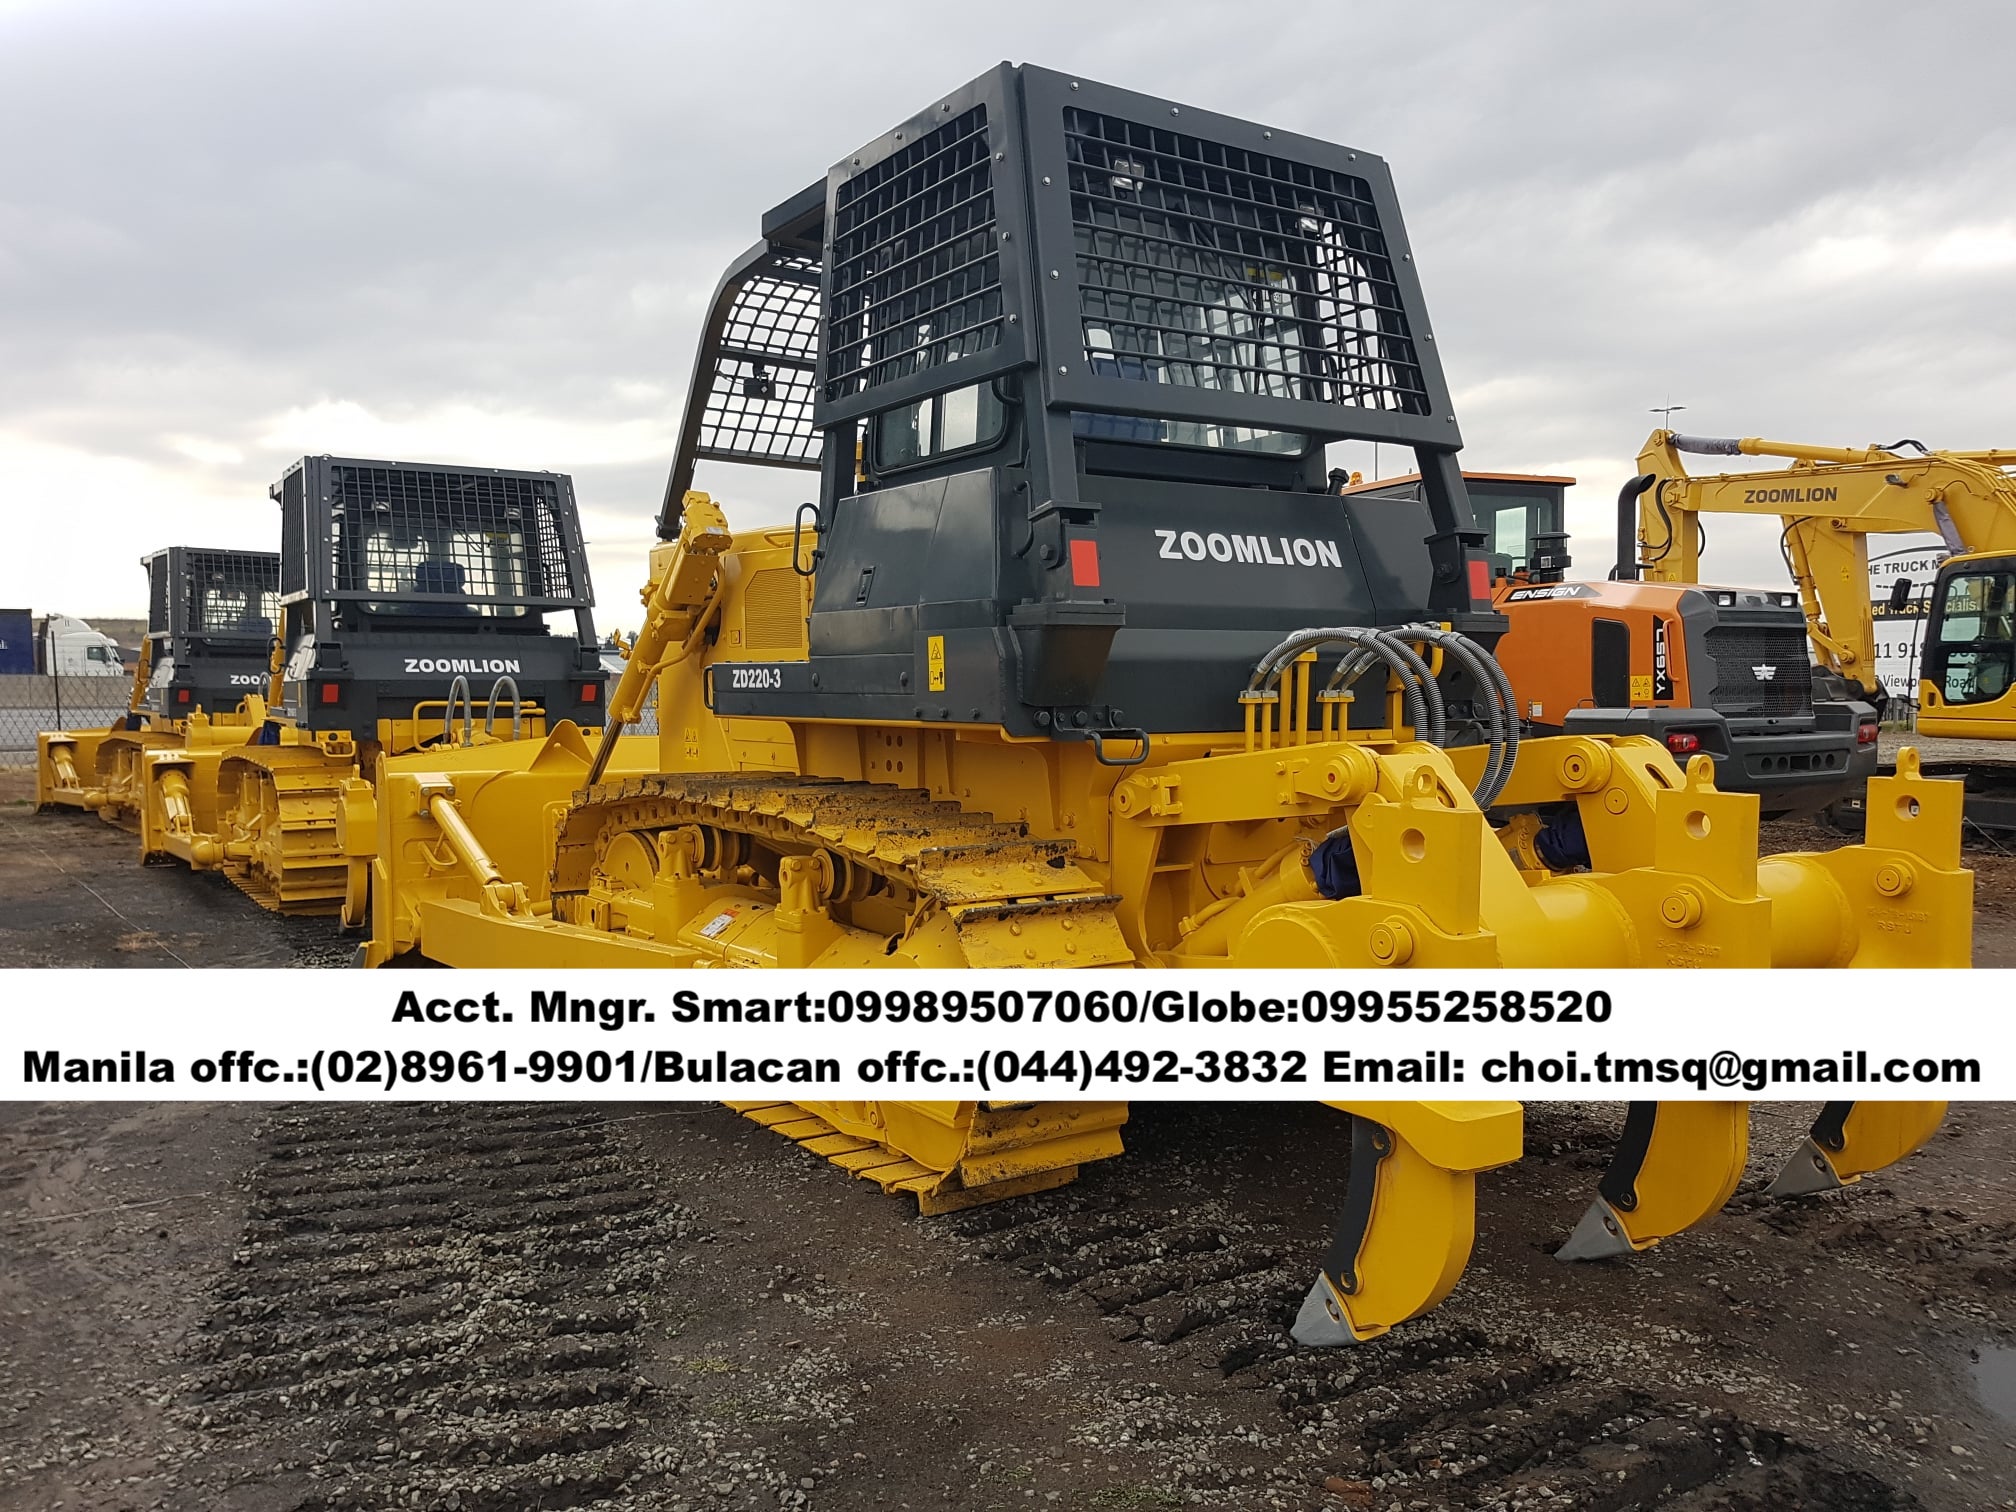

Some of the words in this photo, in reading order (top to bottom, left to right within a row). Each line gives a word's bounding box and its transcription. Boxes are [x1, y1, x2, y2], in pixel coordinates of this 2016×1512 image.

[1743, 487, 1838, 504] ZOOMLION
[1154, 529, 1343, 568] ZOOMLION
[1868, 564, 1881, 575] HE
[1883, 560, 1929, 574] TRUCK
[1510, 586, 1581, 600] ENSIGN
[1874, 642, 1892, 659] 11
[404, 659, 520, 673] ZOOMLION
[1656, 628, 1667, 694] YX657
[732, 668, 782, 689] ZD220-3
